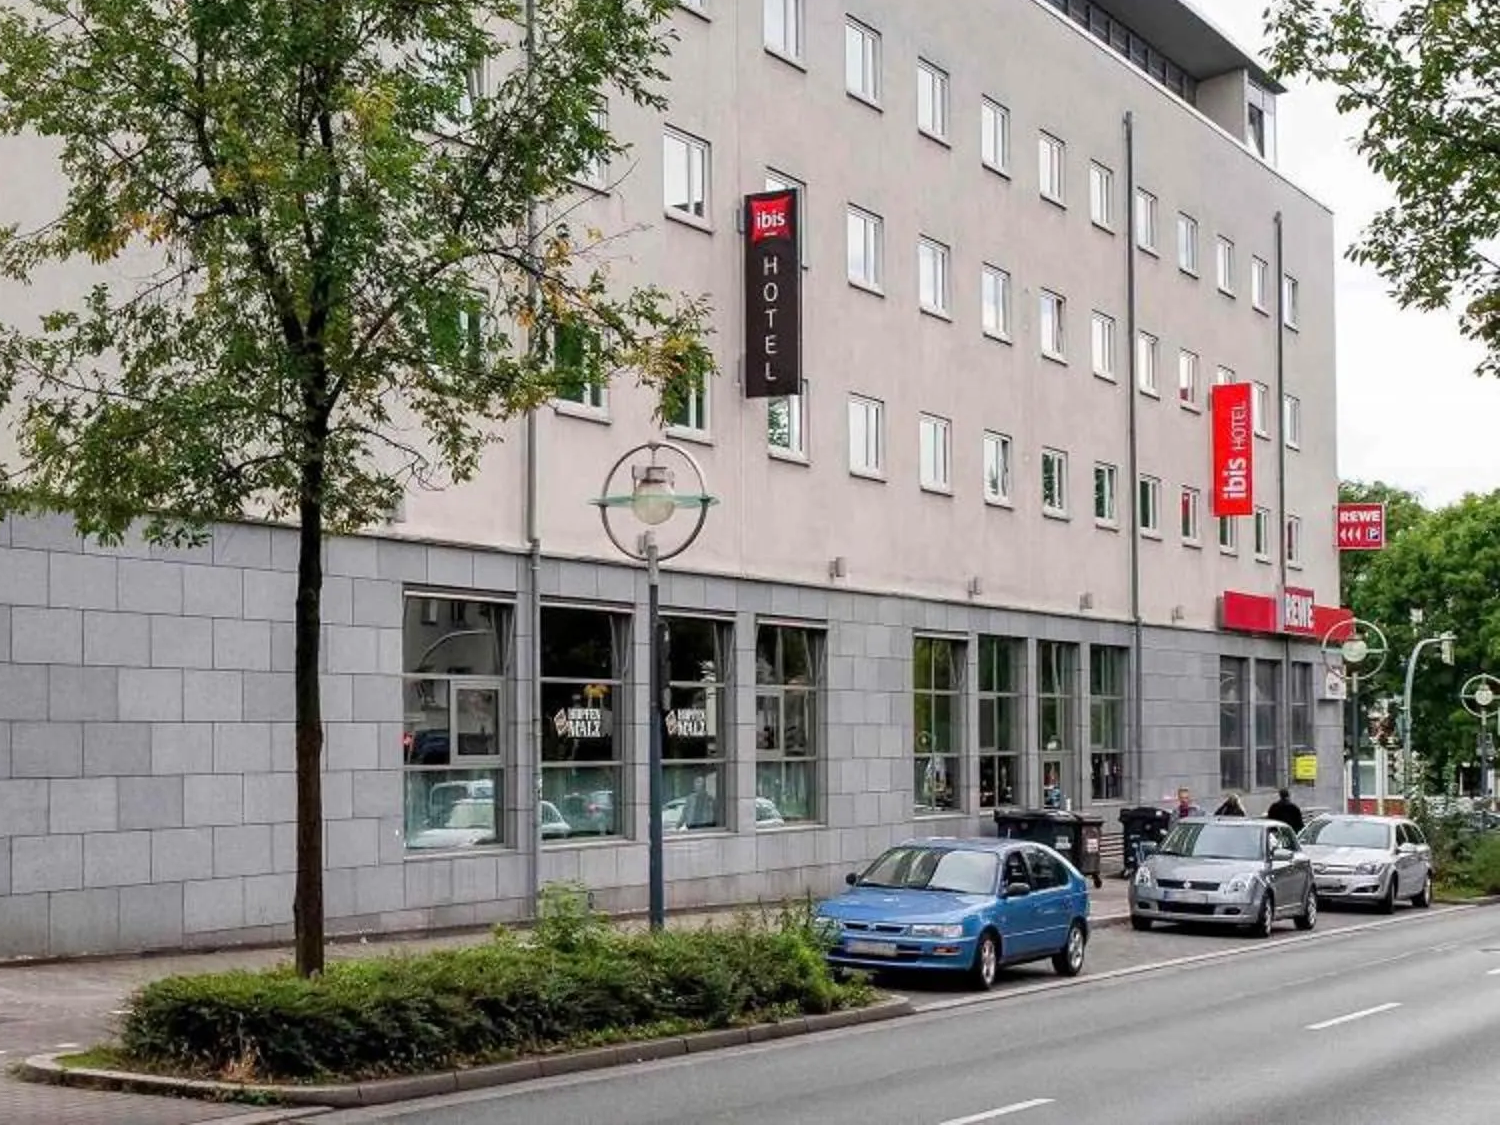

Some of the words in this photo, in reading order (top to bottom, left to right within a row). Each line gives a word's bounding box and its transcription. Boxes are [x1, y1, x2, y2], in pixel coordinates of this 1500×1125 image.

[756, 209, 786, 229] ibis
[763, 255, 779, 382] HOTEL
[1230, 400, 1247, 452] HOTEL
[1222, 458, 1247, 500] ibis
[1339, 510, 1381, 523] REWE
[1285, 592, 1314, 629] REWE
